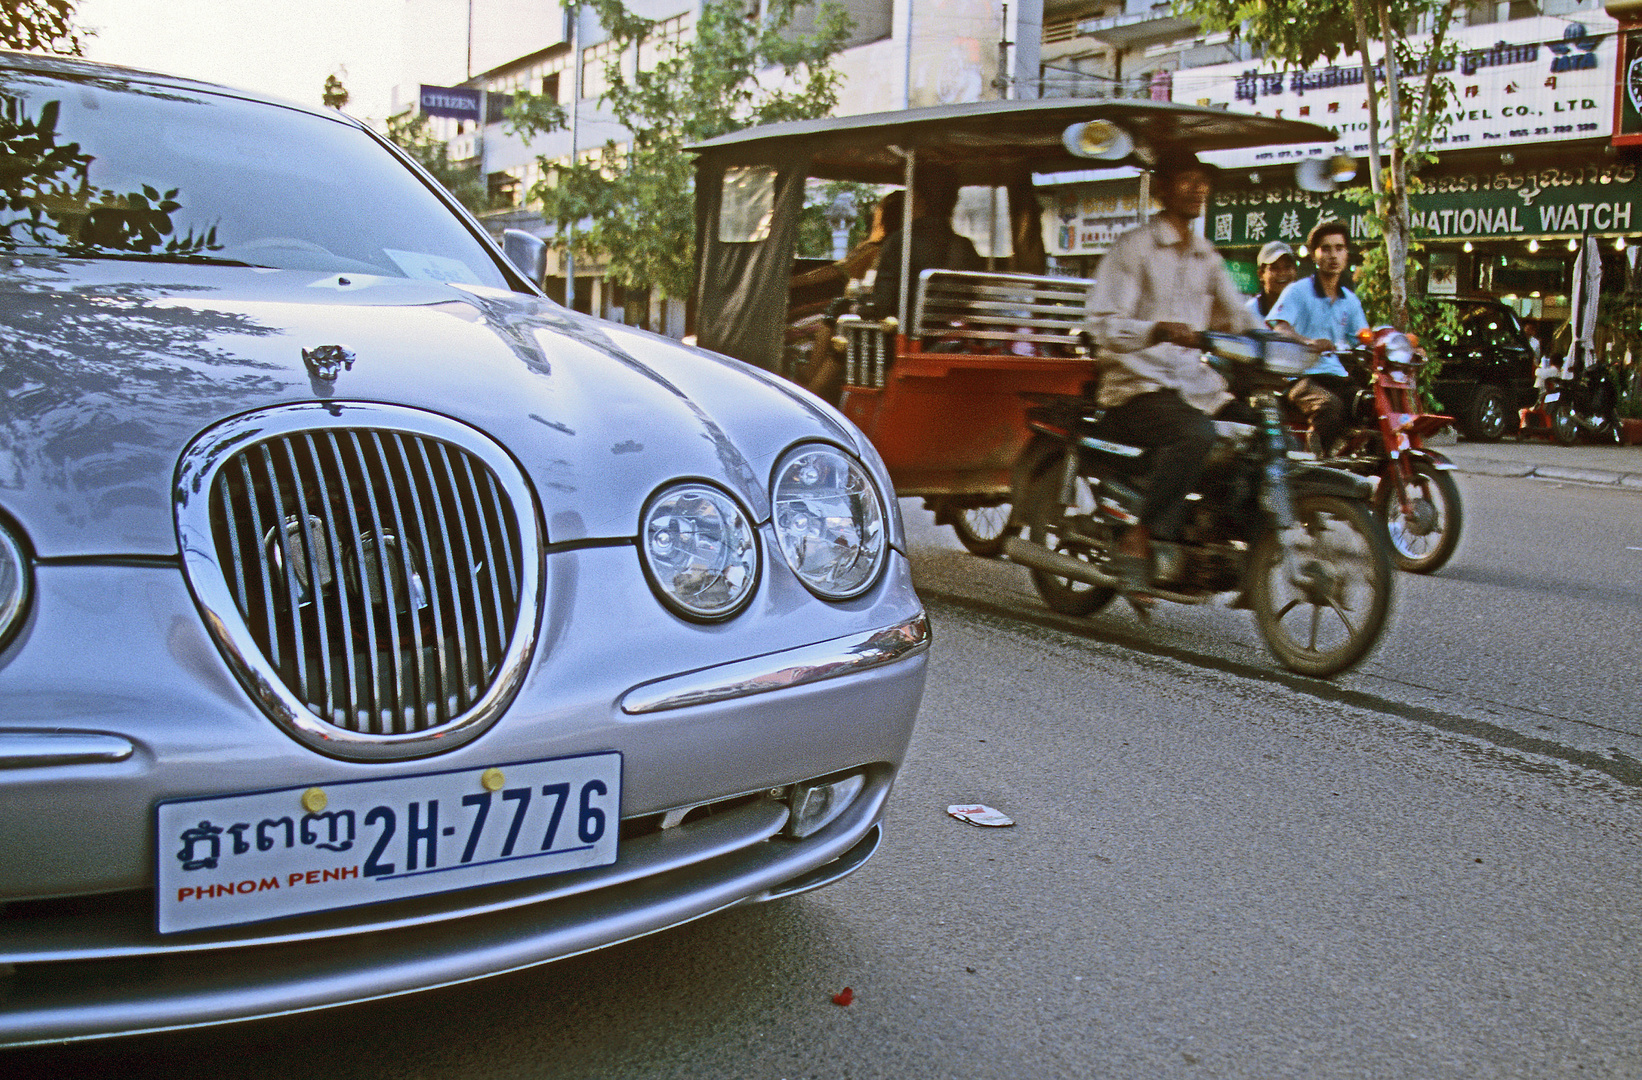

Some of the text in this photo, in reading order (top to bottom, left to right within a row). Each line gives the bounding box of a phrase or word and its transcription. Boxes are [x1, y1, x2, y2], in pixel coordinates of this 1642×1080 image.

[423, 94, 476, 111] CITIZEN
[1502, 105, 1543, 118] CO.,
[1351, 201, 1631, 238] INNATIONAL WATCH
[363, 779, 608, 878] 2H-7776
[178, 866, 359, 902] PHNOM PENH
